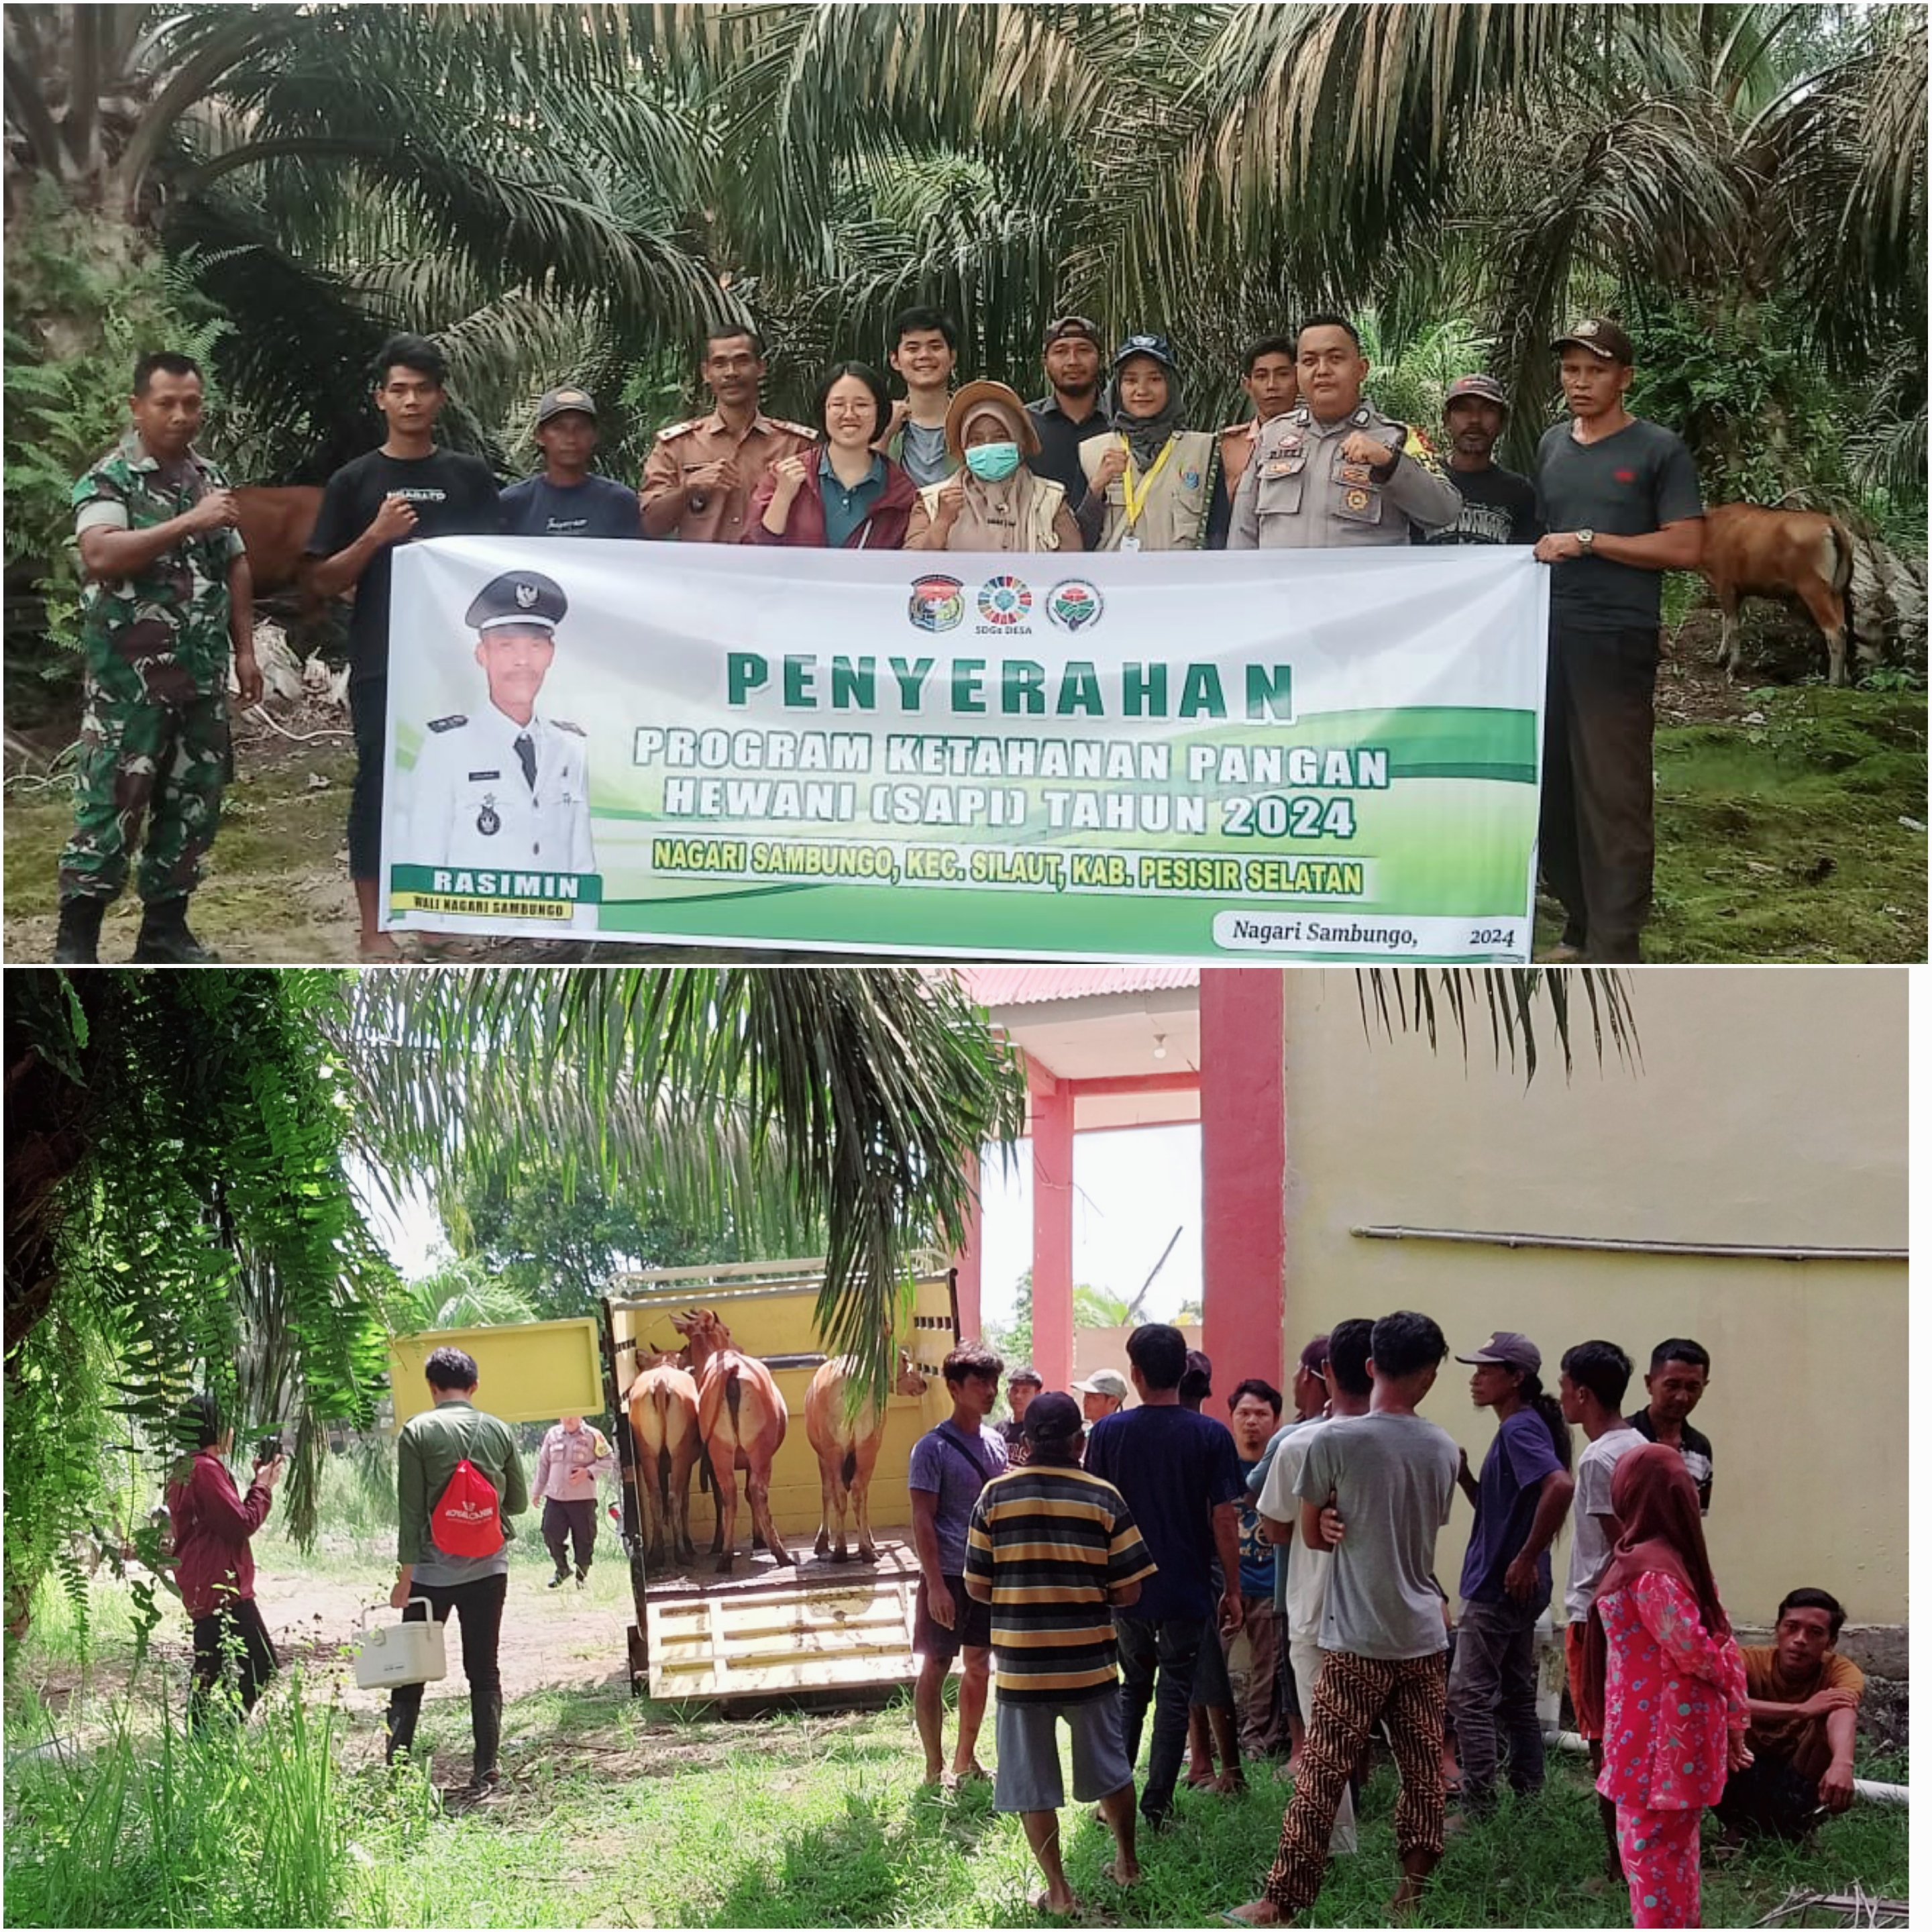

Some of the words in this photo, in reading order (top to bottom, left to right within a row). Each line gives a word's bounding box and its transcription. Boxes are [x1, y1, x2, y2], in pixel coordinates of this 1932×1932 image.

[1005, 625, 1032, 635] DESA
[727, 652, 1292, 720] PENYERAHAN
[633, 727, 872, 772] PROGRAM
[886, 733, 1170, 782] KETAHANAN
[1187, 745, 1390, 789] PANGAN
[664, 776, 856, 822] HEWANI
[1044, 790, 1206, 835] TAHUN
[1221, 795, 1356, 839] 2024
[433, 870, 579, 899] RASIMIN
[653, 839, 747, 873] NAGARI
[752, 843, 900, 884] SAMBUNGO,
[906, 849, 965, 879] KEC.
[970, 851, 1065, 892] SILAUT,
[1073, 854, 1134, 887] KAB.
[1140, 858, 1242, 890] PESISIR
[1245, 861, 1364, 894] SELATAN
[413, 896, 439, 910] WALI
[443, 898, 489, 914] NAGARI
[492, 902, 564, 917] SAMBUNGO
[1232, 919, 1302, 943] Nagari
[1307, 922, 1418, 947] Sambungo,
[1469, 928, 1515, 948] 2024
